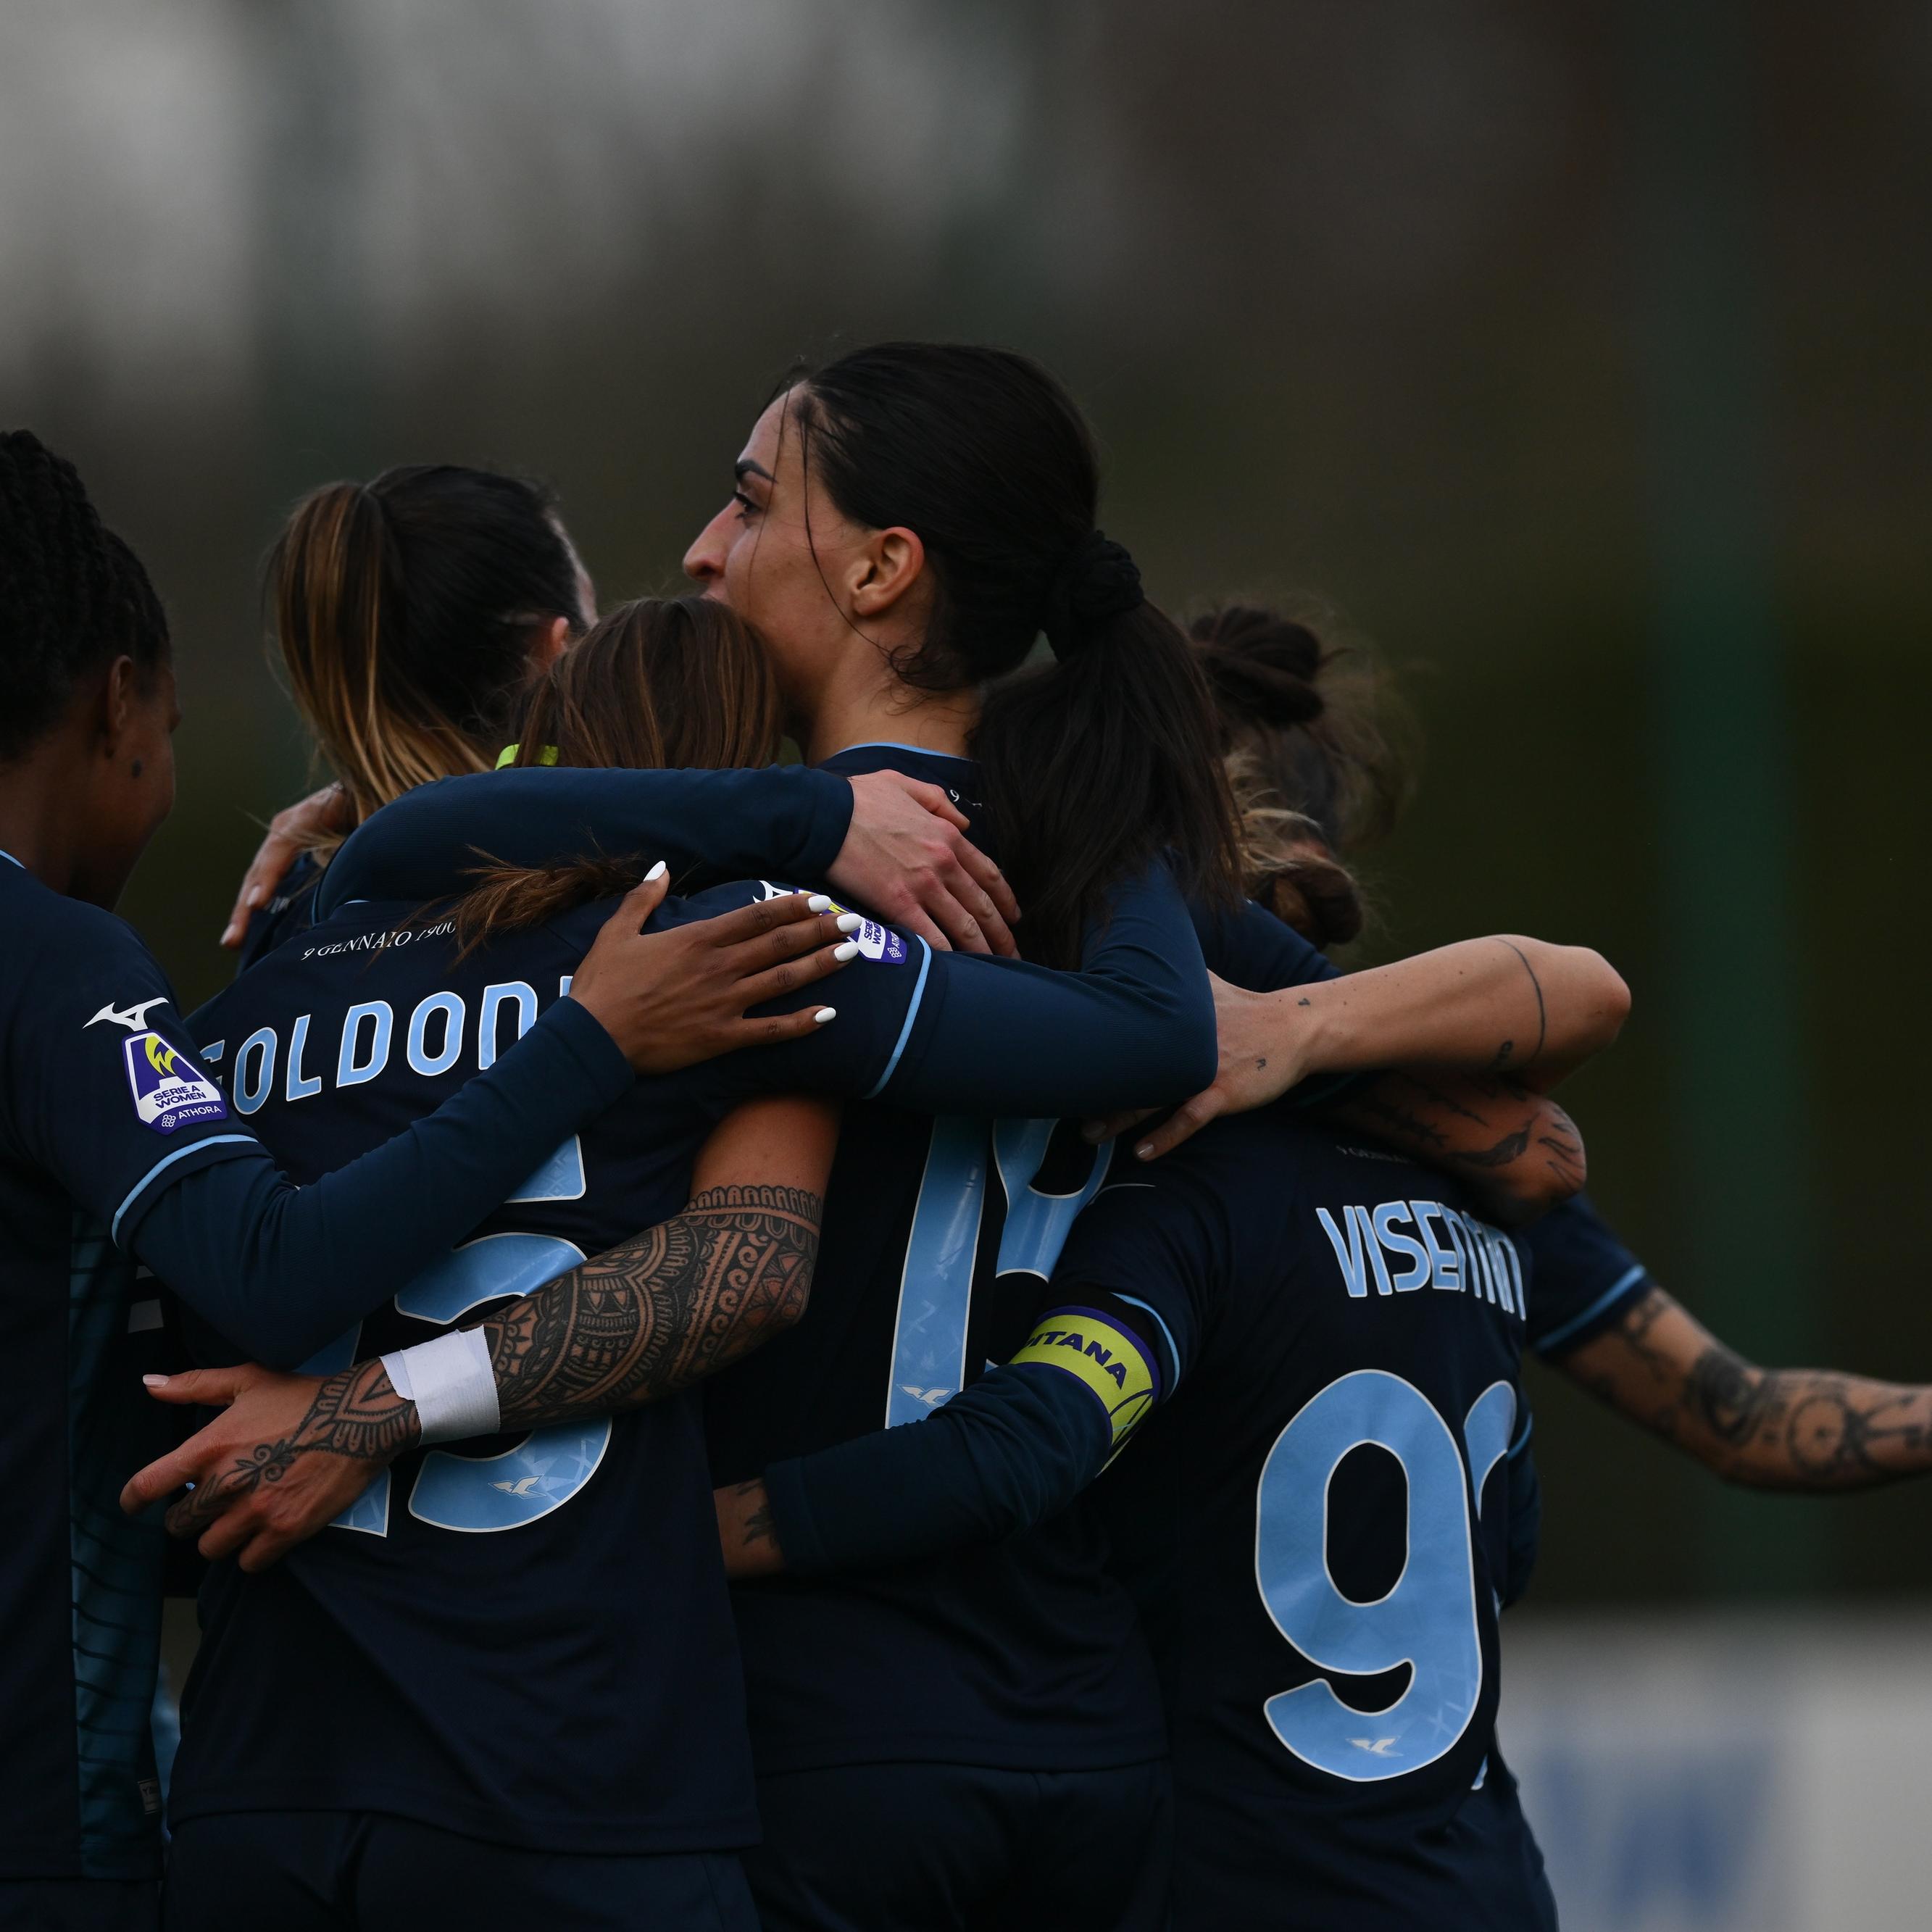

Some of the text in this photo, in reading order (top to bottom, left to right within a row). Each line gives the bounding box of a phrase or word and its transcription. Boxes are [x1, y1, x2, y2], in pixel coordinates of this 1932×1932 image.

[301, 948, 315, 961] 9
[317, 931, 412, 957] GENNAIO
[199, 975, 574, 1115] OLDON
[154, 1086, 189, 1101] SERIE
[156, 1092, 207, 1109] WOMEN
[178, 1106, 222, 1120] ATHORA
[1025, 1332, 1127, 1390] ITANA
